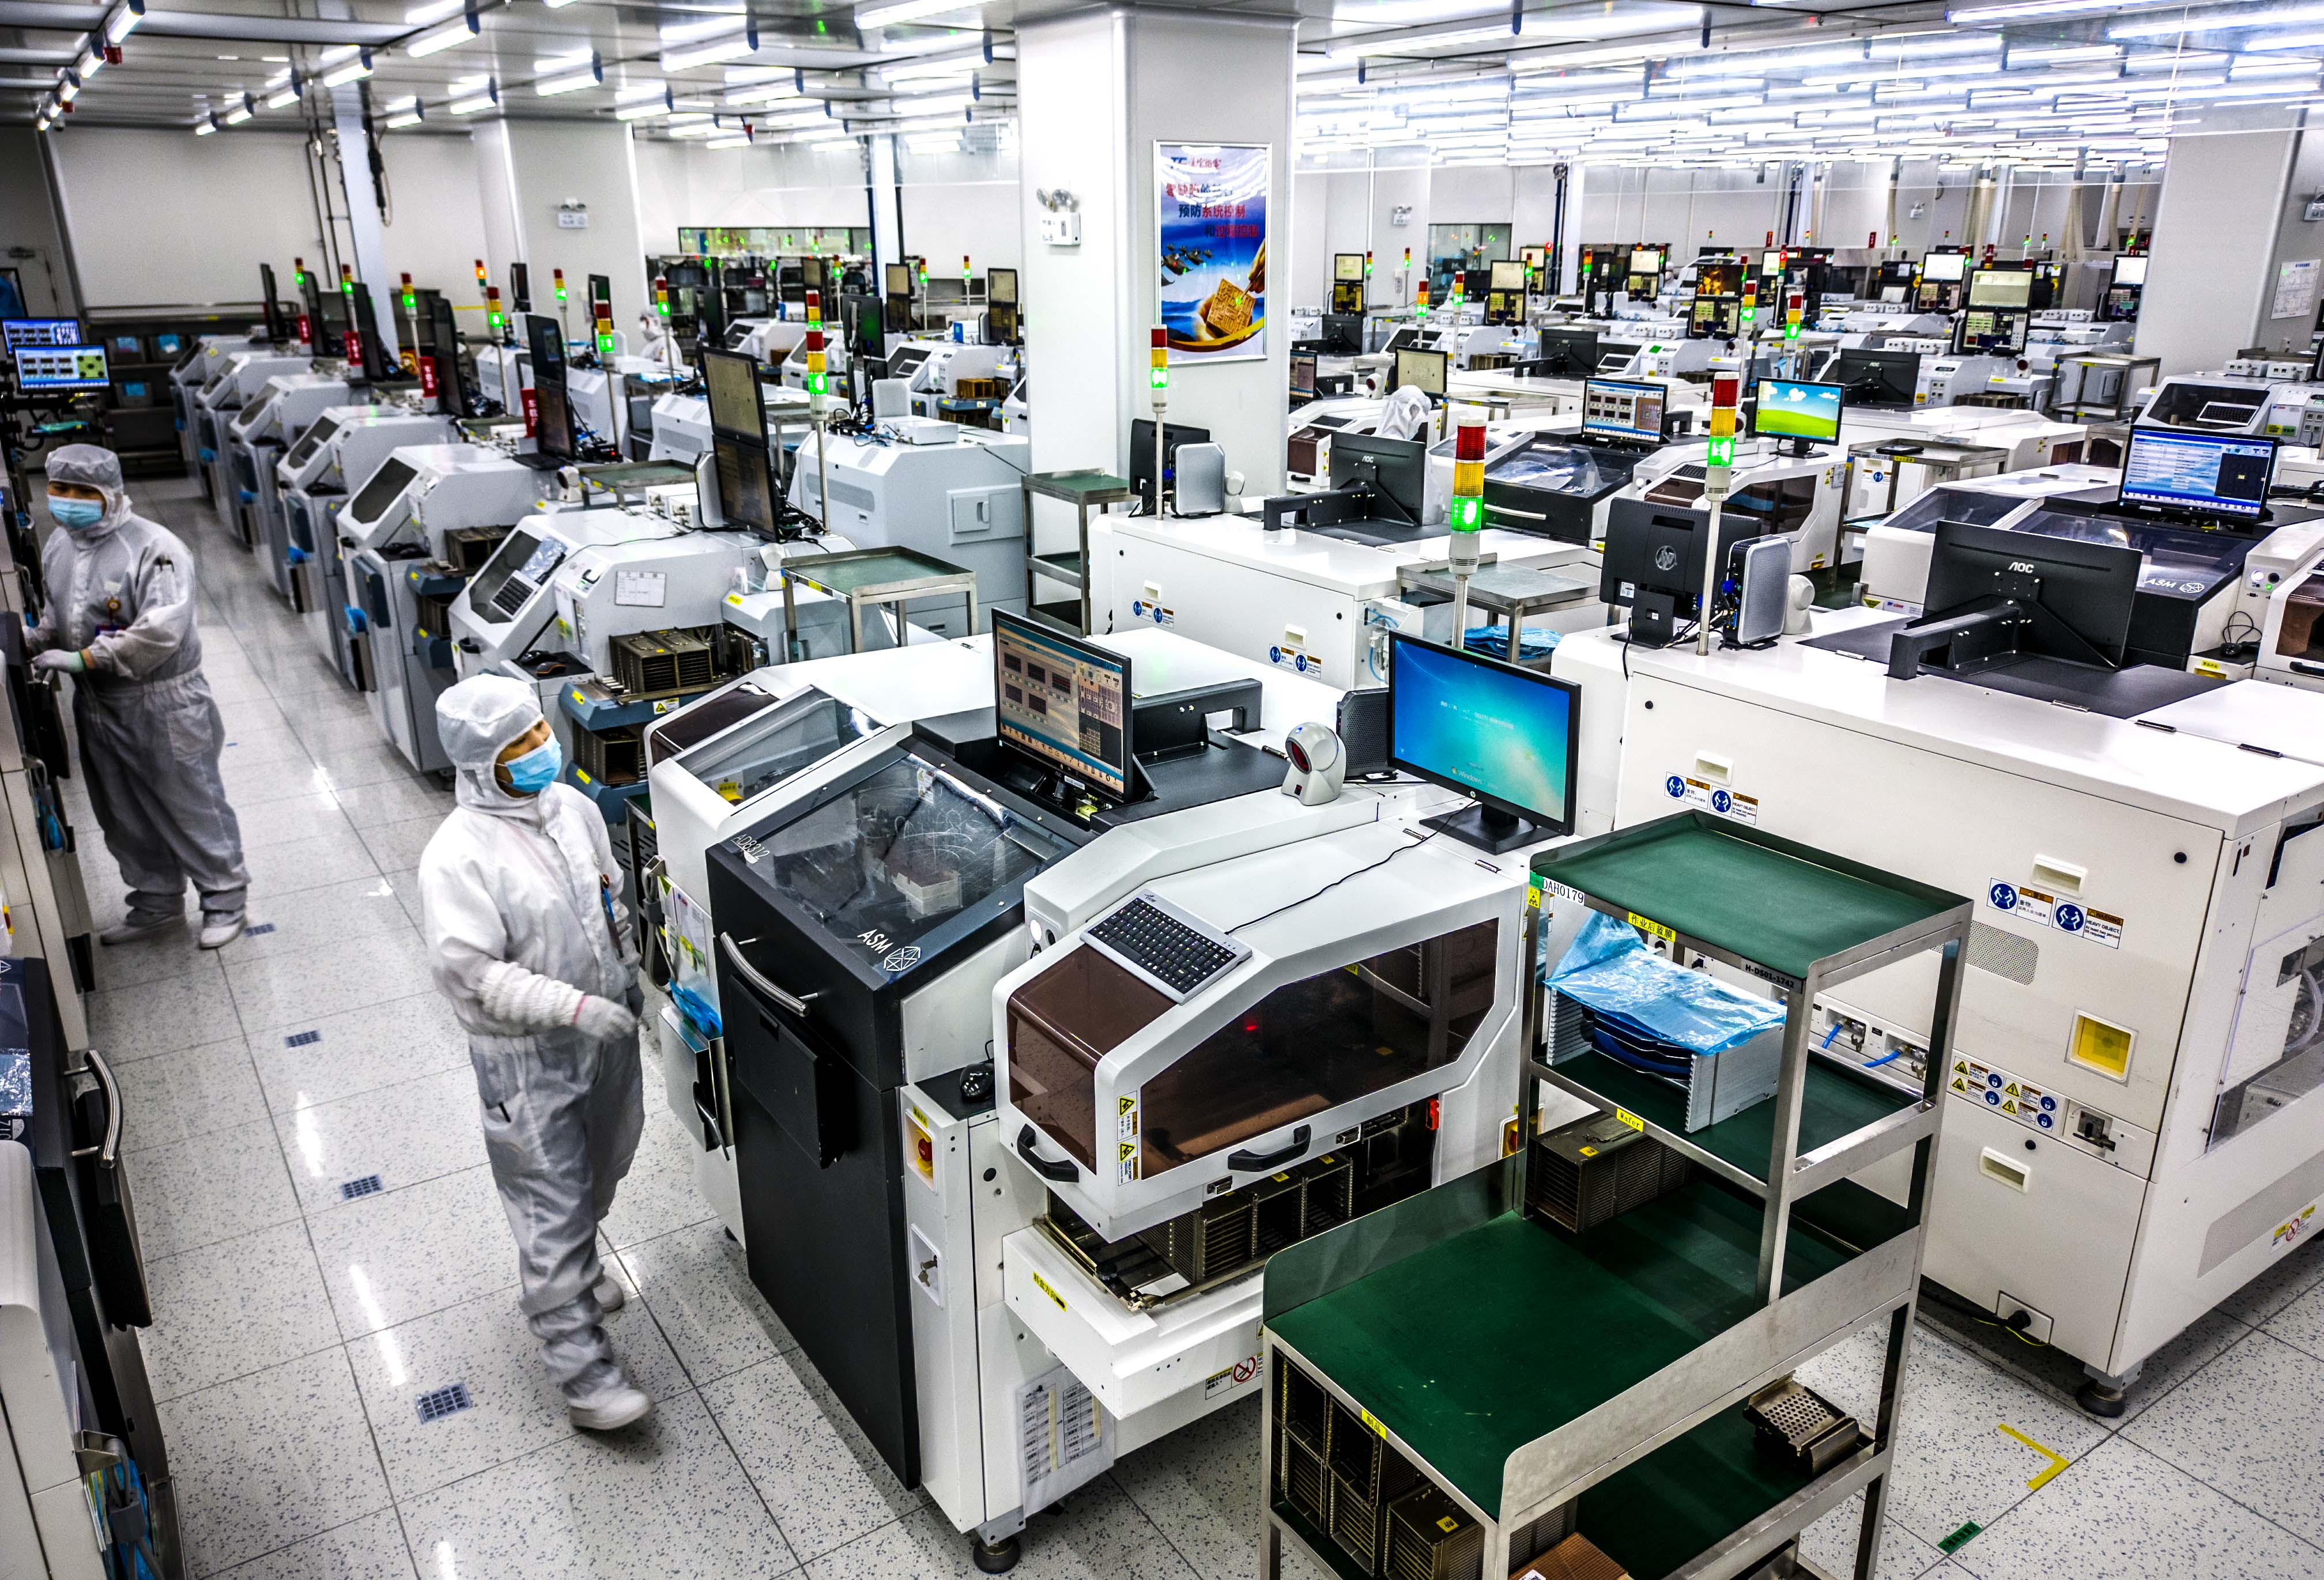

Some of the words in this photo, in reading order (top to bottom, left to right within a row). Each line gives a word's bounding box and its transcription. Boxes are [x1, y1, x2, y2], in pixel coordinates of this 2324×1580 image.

[1179, 203, 1245, 218] 预防系统控制
[2008, 562, 2034, 573] AOC
[2144, 579, 2176, 588] ASM
[733, 834, 770, 860] AD8312
[1542, 878, 1584, 903] DAH0179
[1632, 914, 1673, 940] 作业后蓝膜
[2087, 919, 2101, 927] HEAVY
[857, 929, 894, 954] ASM
[1745, 964, 1794, 988] H-DS01-1742
[1621, 1112, 1640, 1128] Wafer
